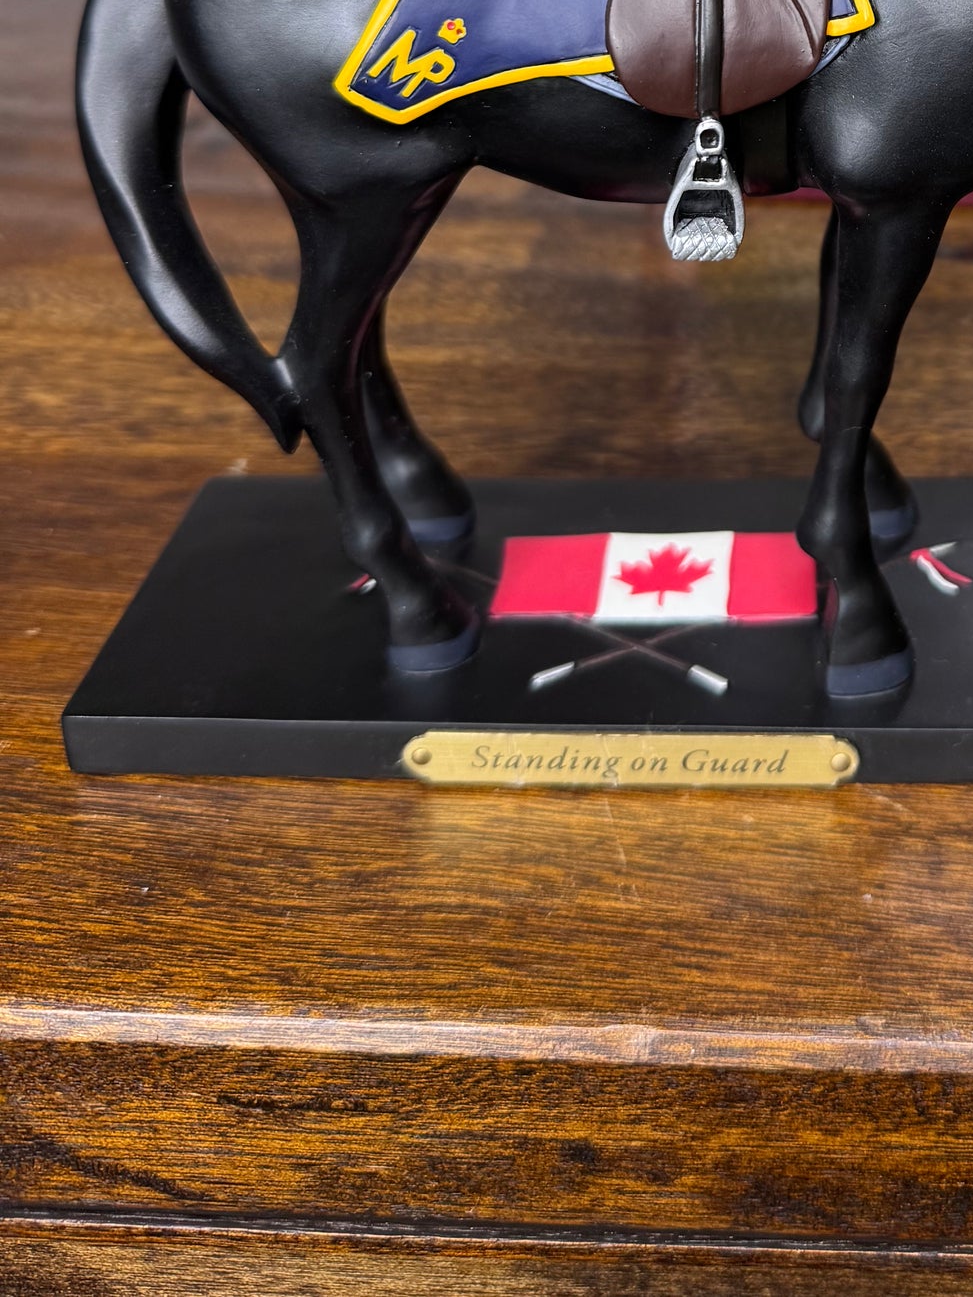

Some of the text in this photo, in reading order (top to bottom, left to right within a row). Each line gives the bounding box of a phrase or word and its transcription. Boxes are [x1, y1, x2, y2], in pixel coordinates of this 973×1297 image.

[470, 744, 790, 778] Standing on Guard
